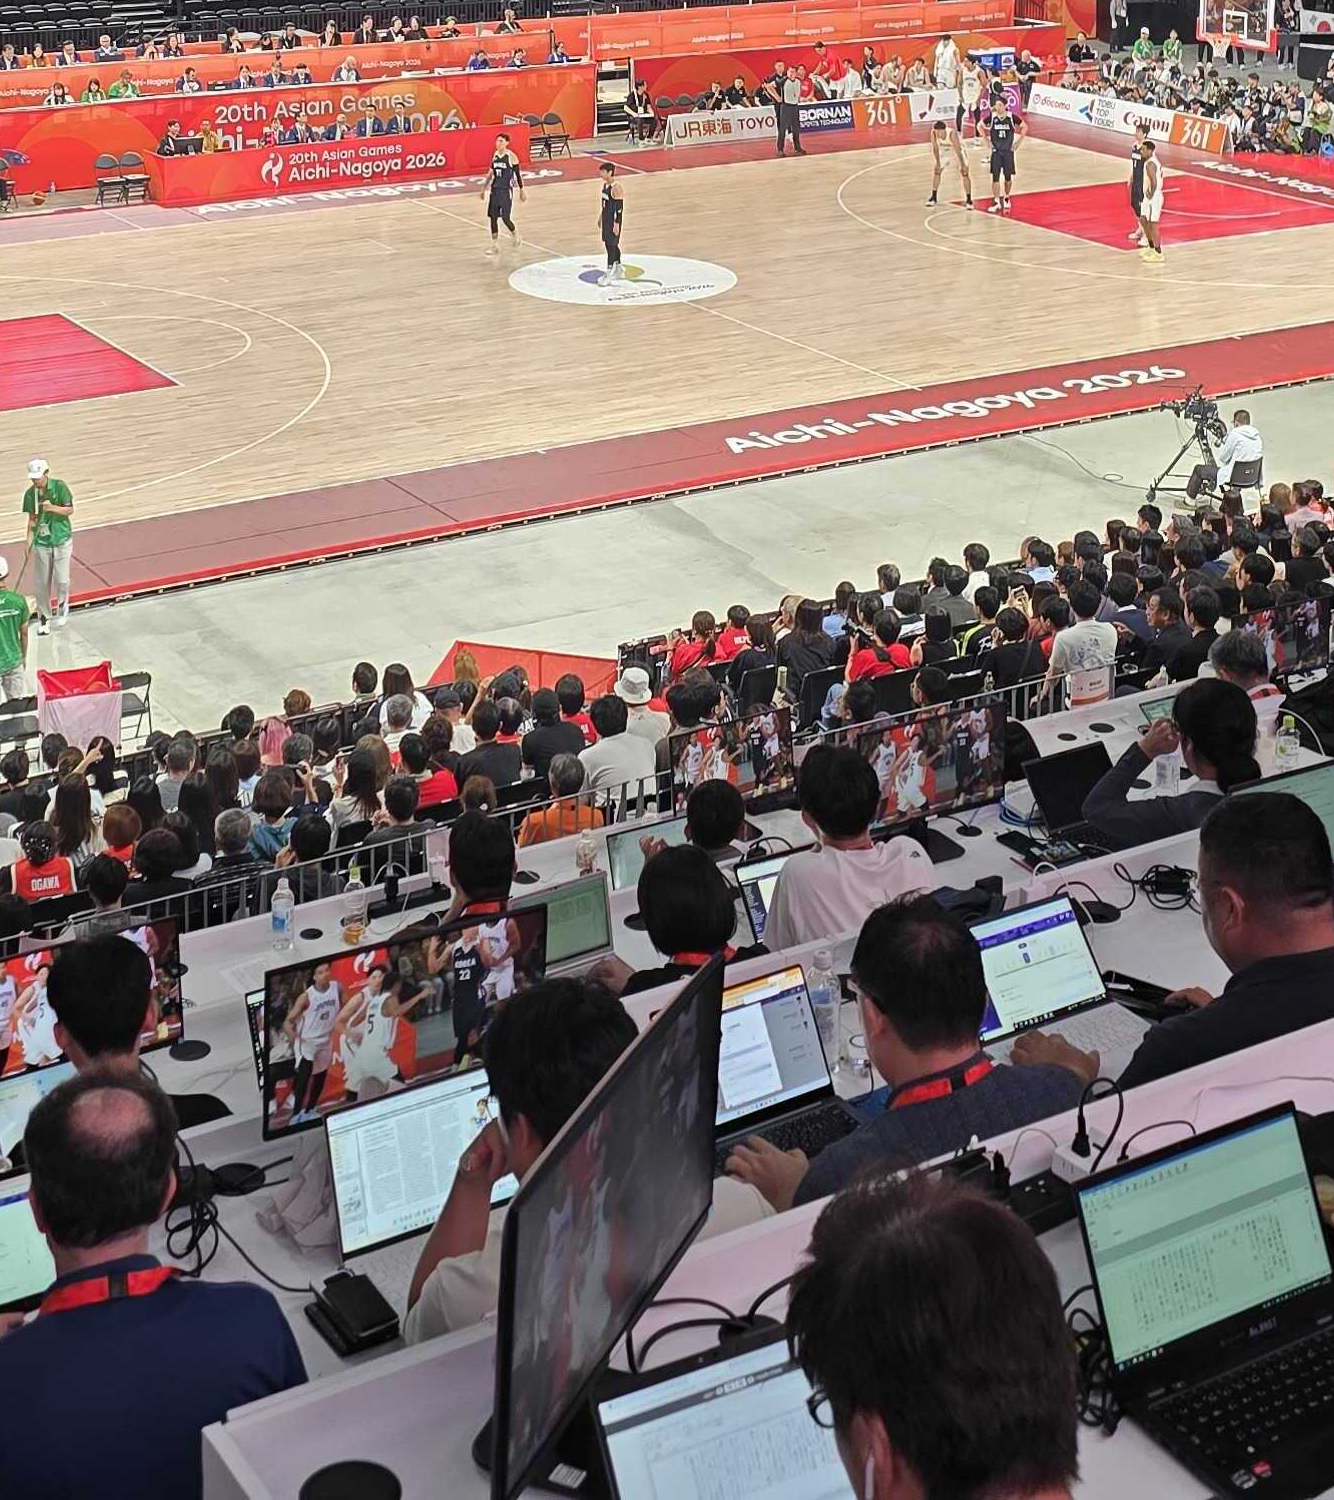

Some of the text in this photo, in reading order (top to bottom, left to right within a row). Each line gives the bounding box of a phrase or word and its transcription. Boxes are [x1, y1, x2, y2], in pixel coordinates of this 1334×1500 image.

[214, 90, 415, 125] 20th Asian Games
[799, 104, 851, 121] BORNAN
[675, 117, 733, 140] JR東海
[737, 113, 774, 130] TOYO
[1123, 111, 1170, 133] Canon
[289, 143, 403, 165] 20th Asian Games
[289, 152, 446, 182] Aichi-Nagoya 2026
[196, 179, 466, 214] Aichi-Nagoya
[724, 364, 1186, 454] Aichi-Nagoya 2026
[31, 874, 60, 892] OGAWA
